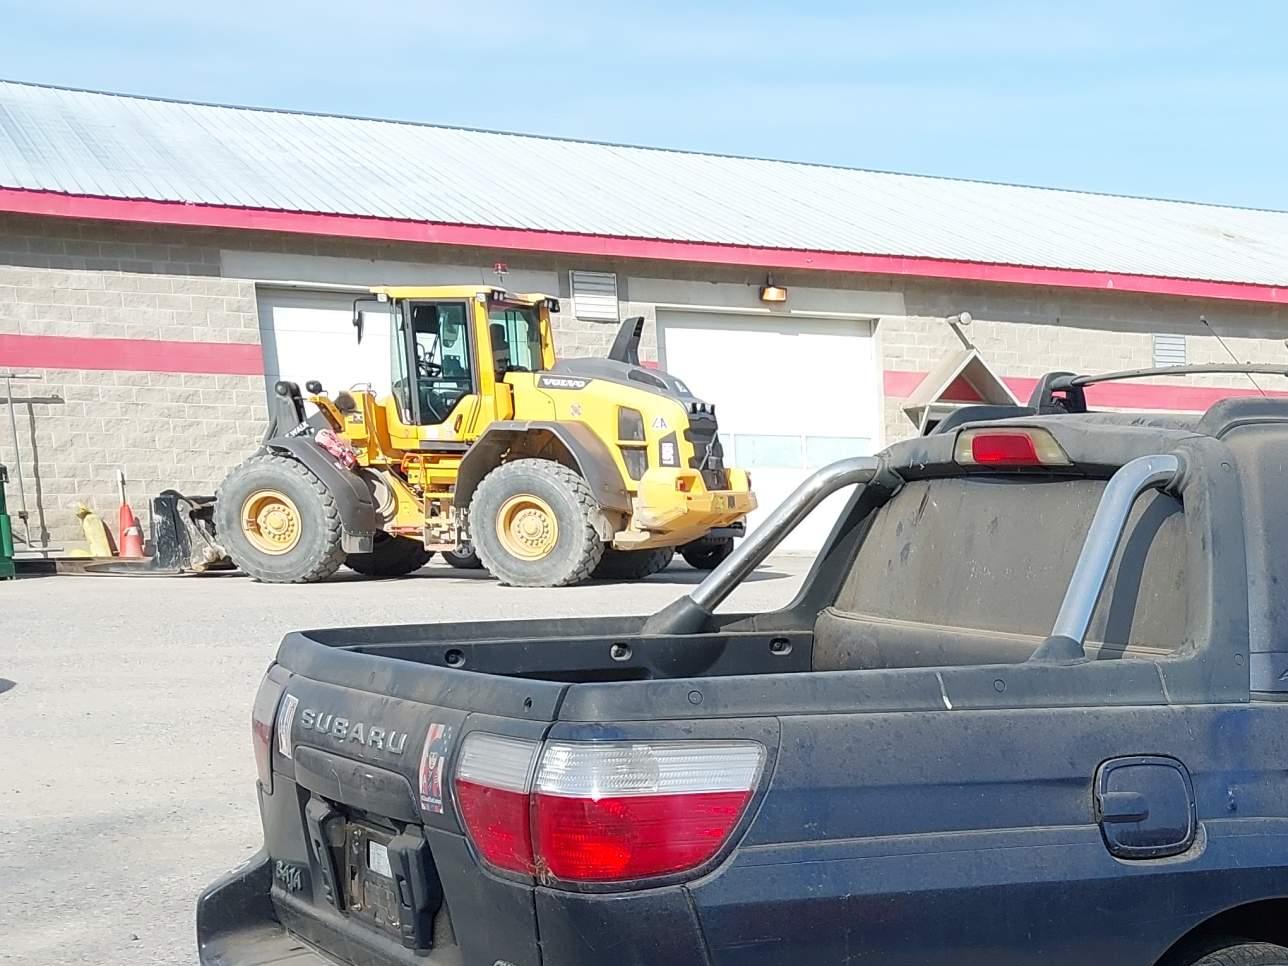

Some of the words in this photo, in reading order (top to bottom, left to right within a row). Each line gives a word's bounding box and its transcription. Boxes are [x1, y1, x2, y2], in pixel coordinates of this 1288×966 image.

[542, 377, 586, 388] VOLVO
[300, 708, 408, 754] SUBARU
[276, 860, 302, 891] BAJA
